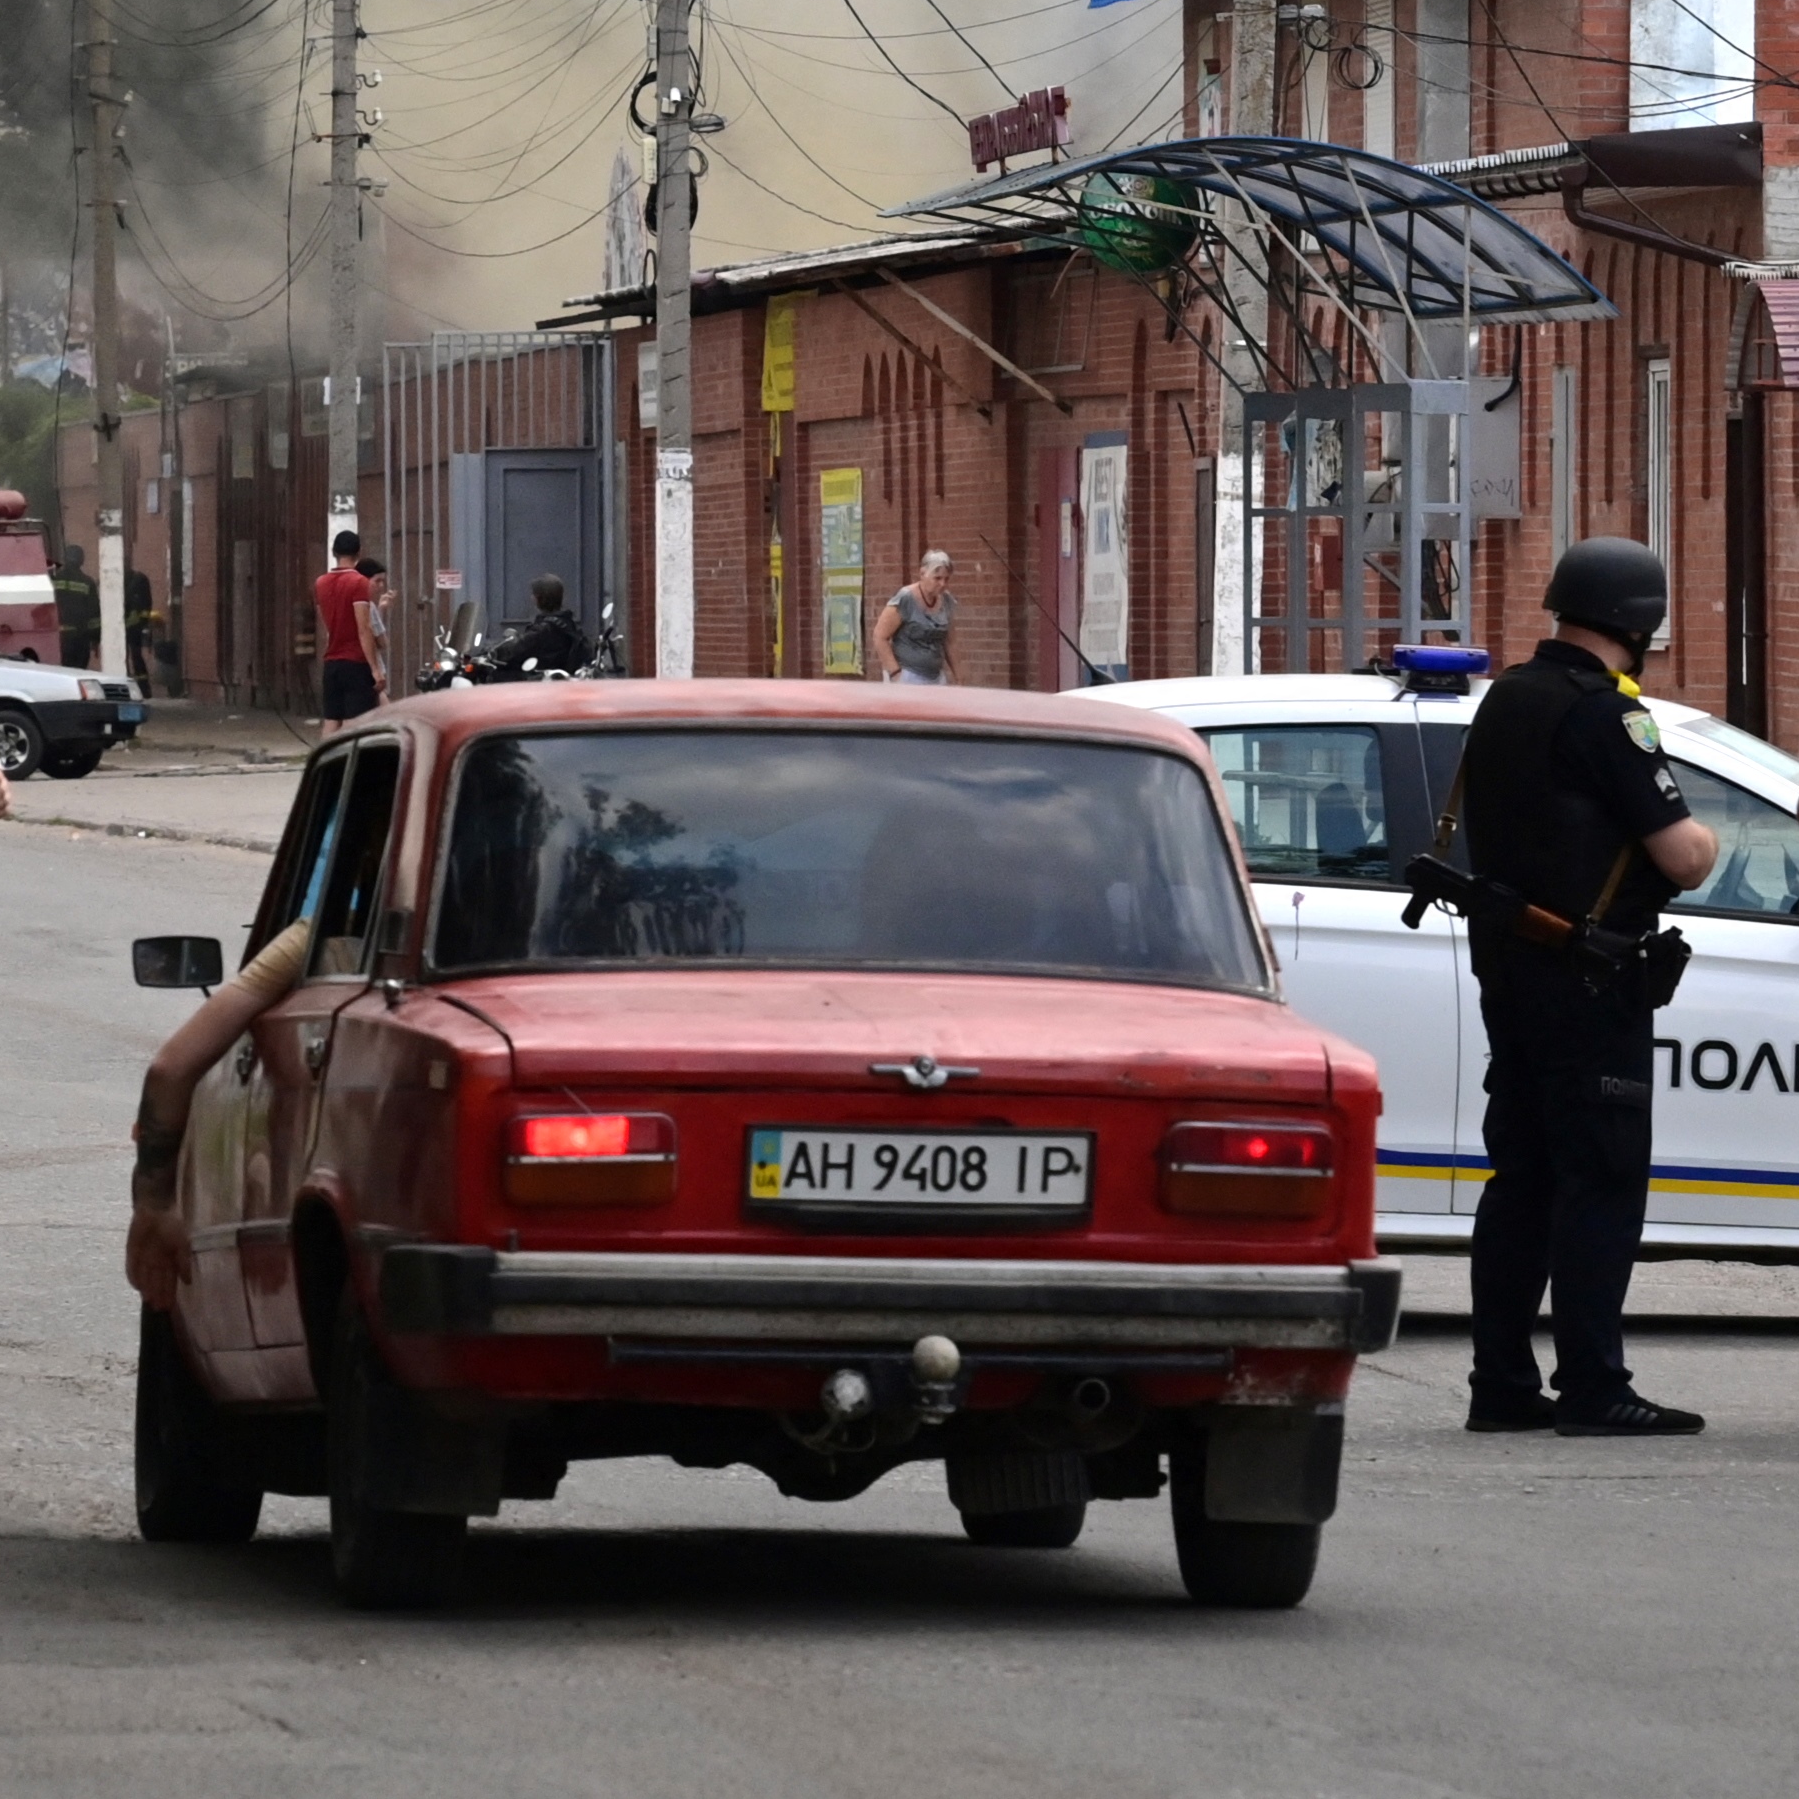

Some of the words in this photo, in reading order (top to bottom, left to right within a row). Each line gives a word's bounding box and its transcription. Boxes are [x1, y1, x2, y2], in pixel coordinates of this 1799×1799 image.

[783, 1141, 855, 1190] AH
[872, 1143, 989, 1193] 9408
[1016, 1145, 1077, 1194] IP
